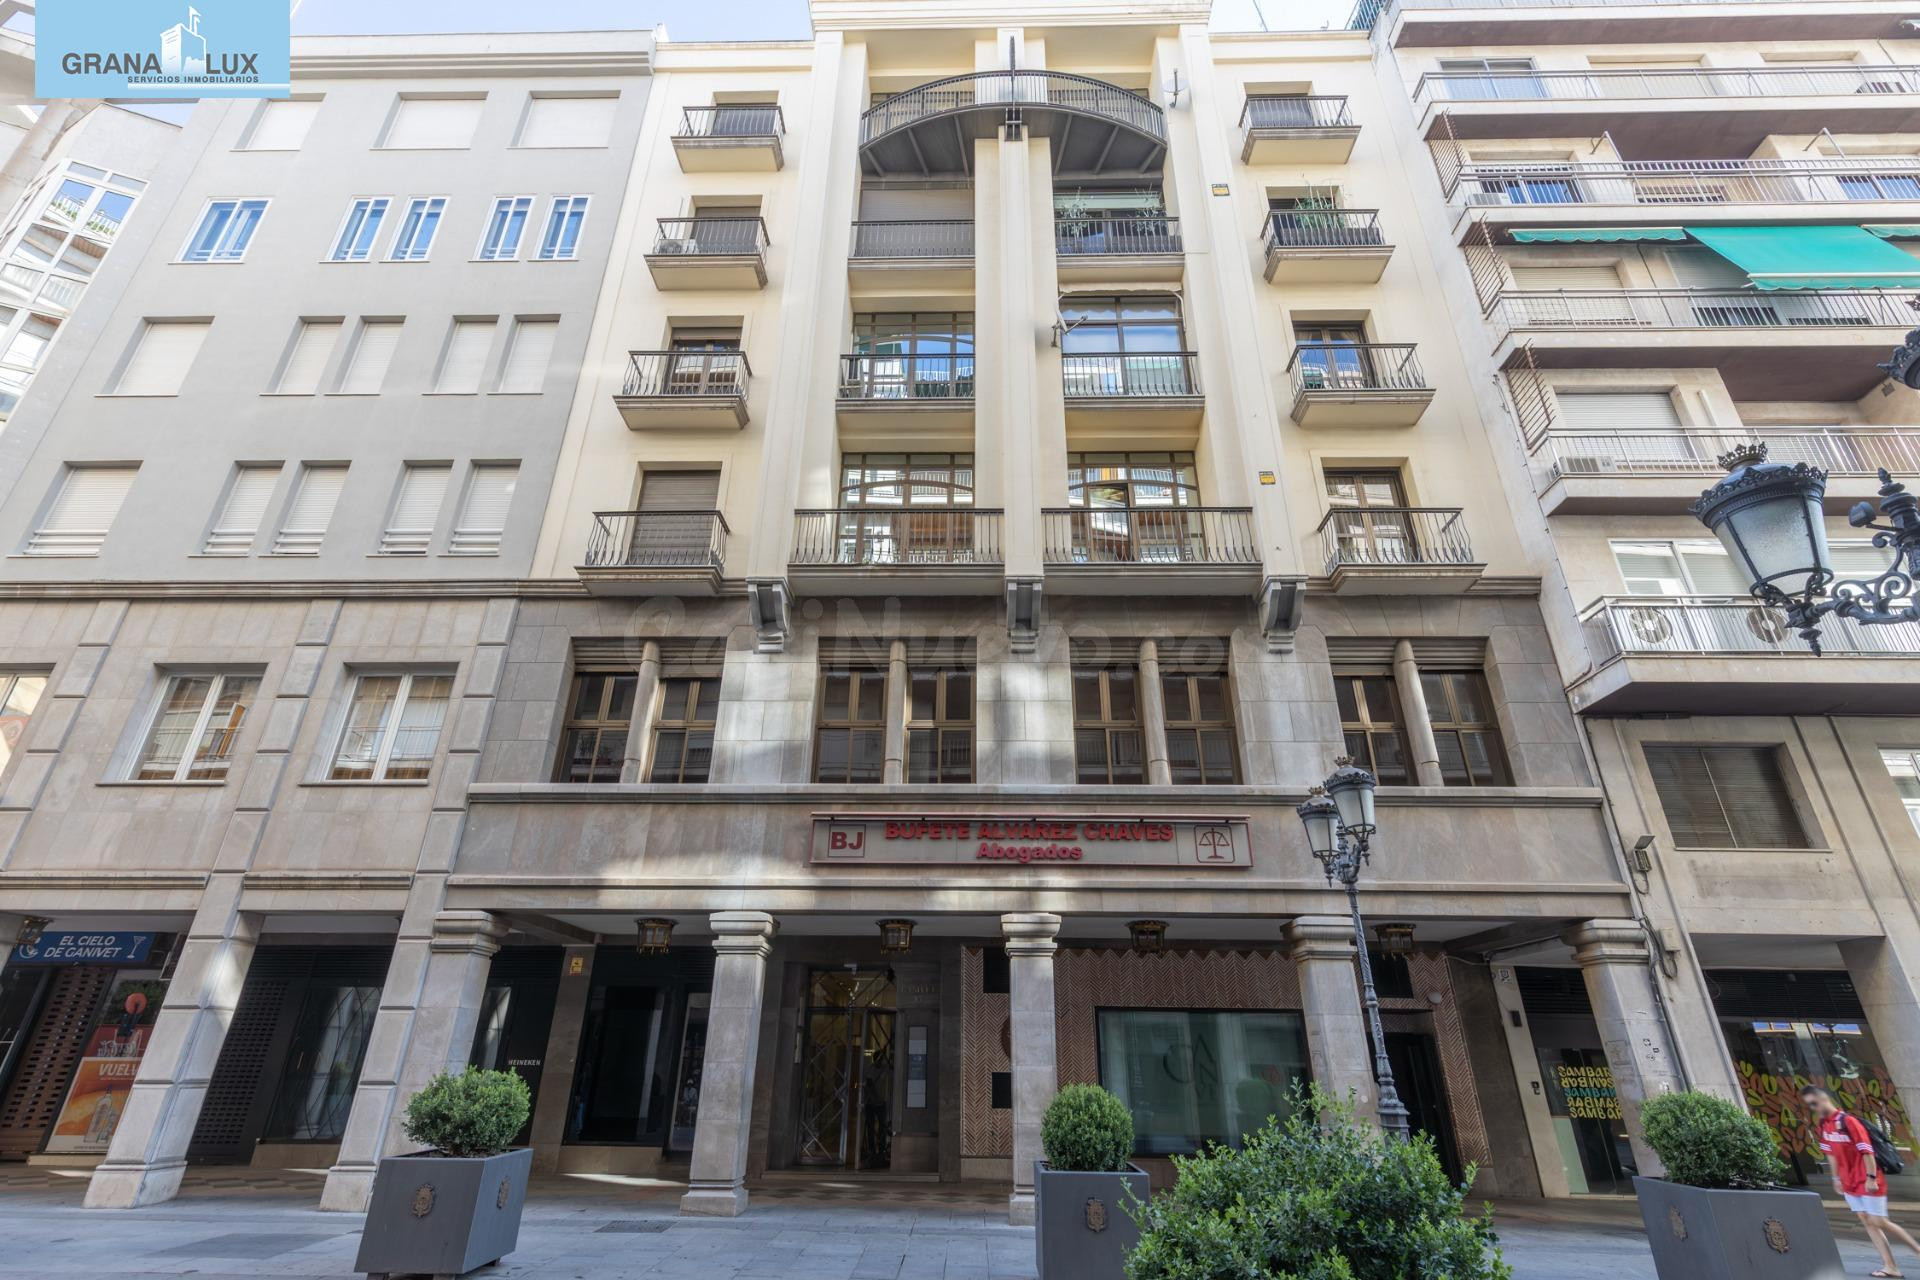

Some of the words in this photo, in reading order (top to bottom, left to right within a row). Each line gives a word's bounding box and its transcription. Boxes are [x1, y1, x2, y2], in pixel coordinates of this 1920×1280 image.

[831, 832, 863, 850] BJ
[885, 823, 970, 840] BUFETE
[977, 823, 1078, 841] ALVAREZ
[1083, 824, 1174, 841] CHAVES
[976, 842, 1083, 864] Abogados
[59, 936, 74, 946] EL
[78, 936, 116, 946] CIELO
[44, 948, 62, 958] DE
[65, 948, 122, 958] GANIVET
